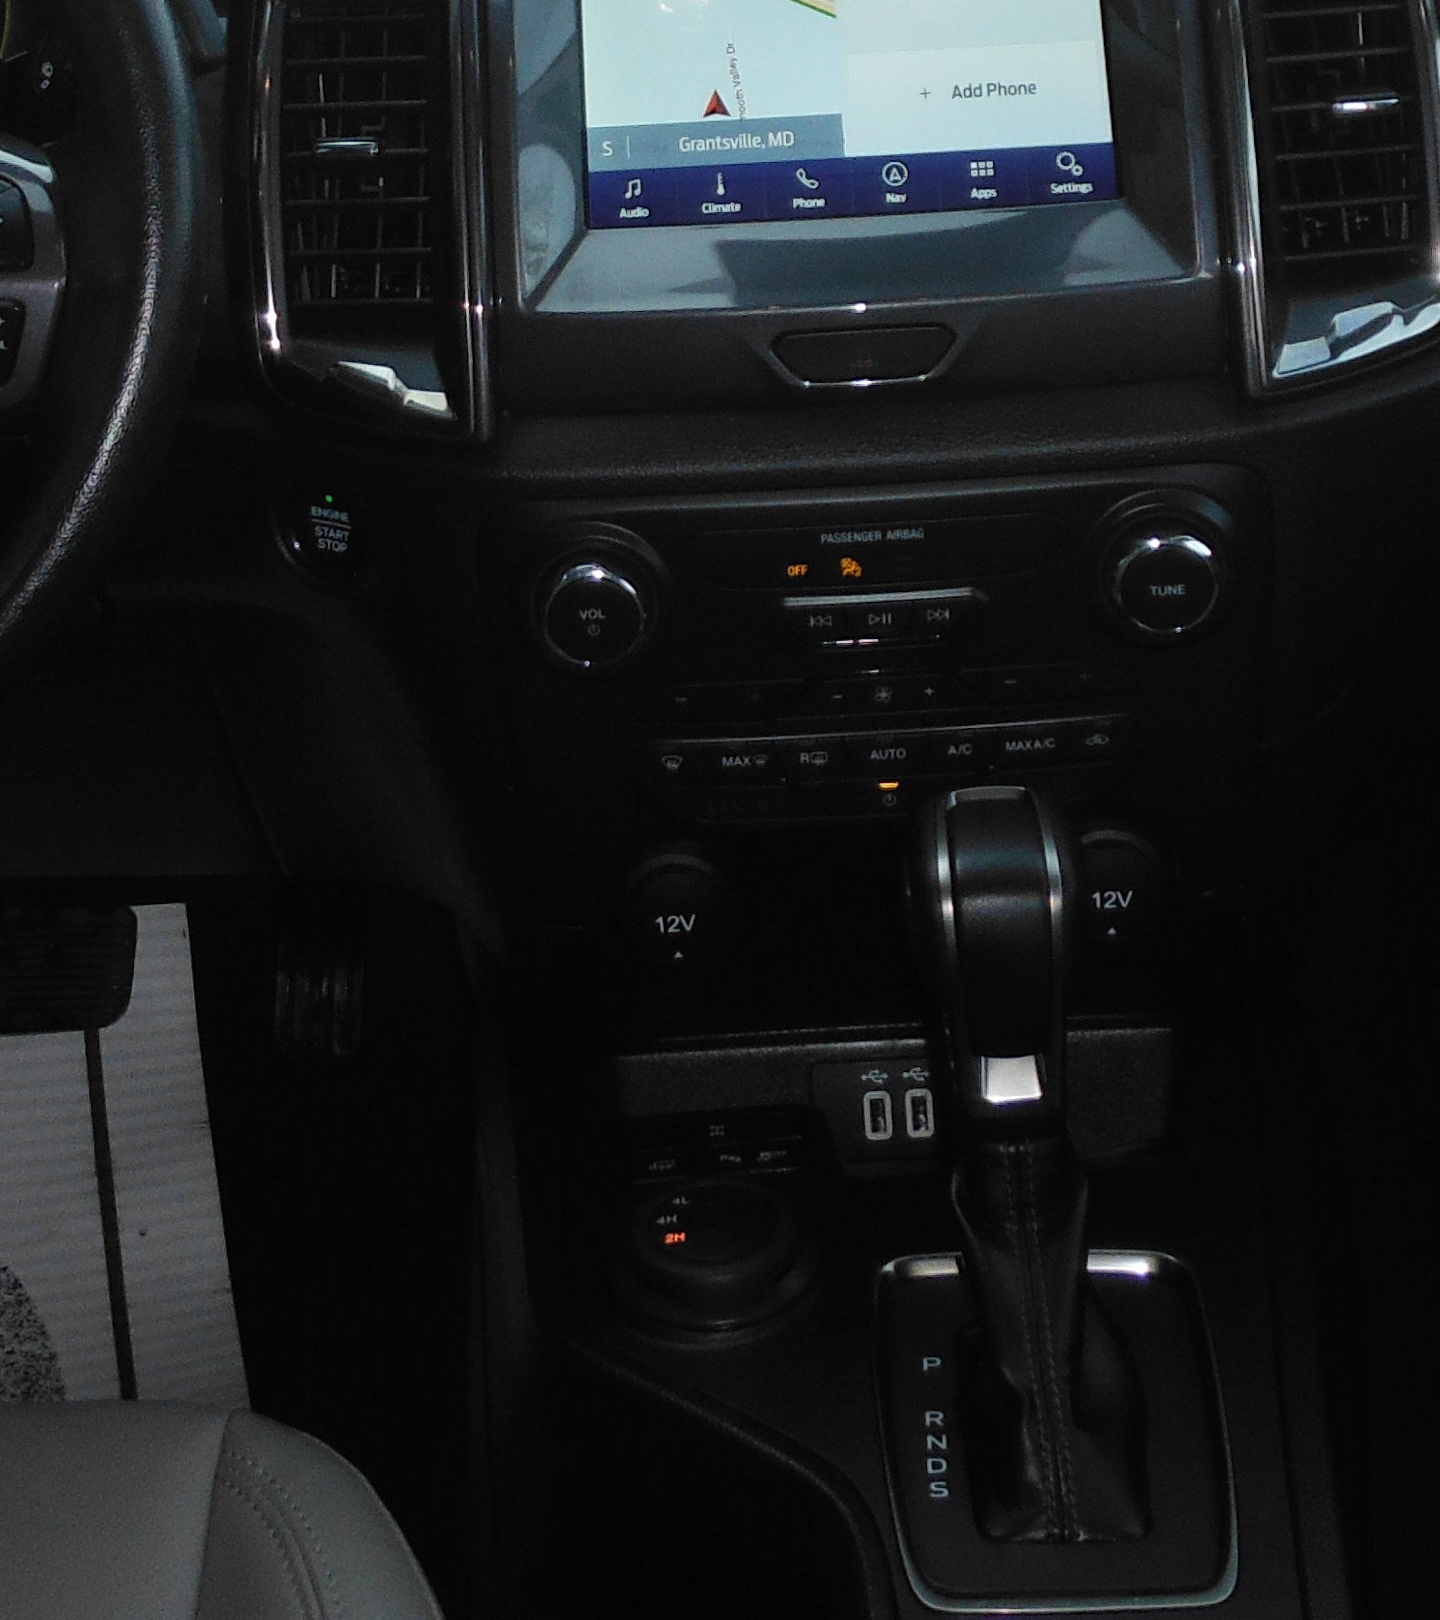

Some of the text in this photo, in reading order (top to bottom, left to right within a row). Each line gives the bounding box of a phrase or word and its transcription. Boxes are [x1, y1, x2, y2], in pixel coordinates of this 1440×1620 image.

[951, 82, 1037, 99] Add Phone
[602, 141, 613, 157] S
[678, 131, 795, 153] Grantsville, MD
[970, 187, 997, 200] Apps
[1050, 181, 1094, 195] Settings
[792, 197, 826, 210] Phone
[886, 192, 907, 204] Nav
[619, 206, 650, 219] Audio
[701, 201, 742, 215] Climate
[311, 506, 350, 522] ENGINE
[314, 525, 350, 541] START
[820, 528, 925, 545] PASSENGER AIRBAG
[317, 538, 348, 552] STOP
[787, 564, 809, 577] OFF
[1150, 584, 1185, 596] TUNE
[579, 608, 606, 620] VOL
[870, 747, 906, 761] AUTO
[948, 743, 972, 756] A/C
[722, 755, 751, 767] MAX
[800, 752, 809, 763] R
[1091, 891, 1133, 909] 12V
[655, 914, 696, 934] 12V
[664, 1232, 687, 1245] 2H
[923, 1356, 942, 1371] P
[925, 1411, 945, 1427] R
[926, 1434, 948, 1450] N
[926, 1458, 947, 1474] D
[929, 1482, 950, 1498] S
